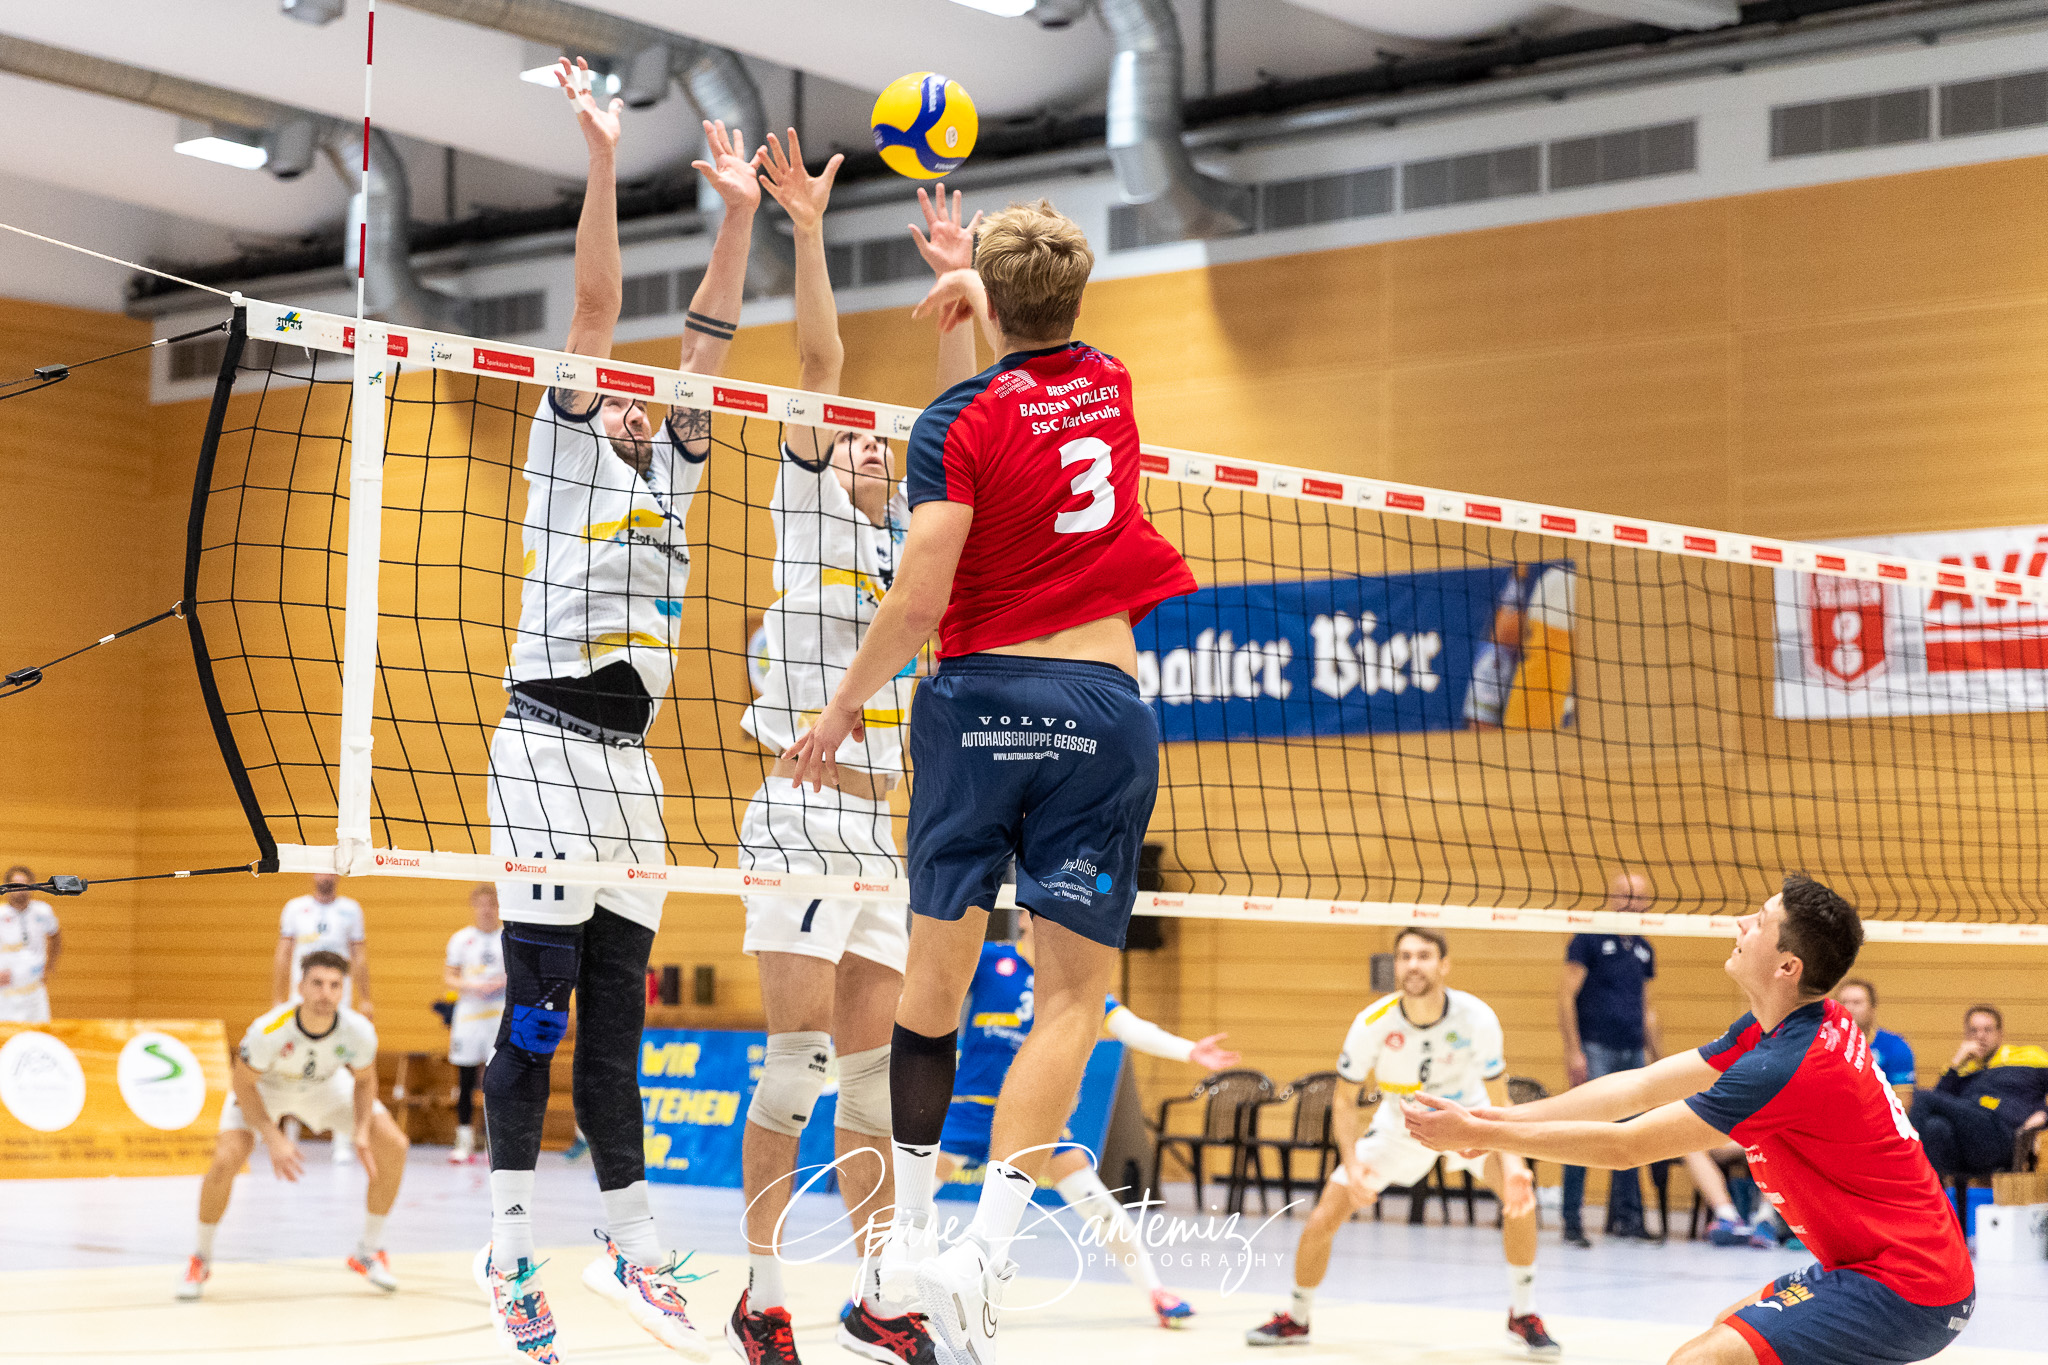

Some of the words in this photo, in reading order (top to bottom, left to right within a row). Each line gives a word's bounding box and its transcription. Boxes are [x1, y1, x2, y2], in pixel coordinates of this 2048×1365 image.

[277, 317, 301, 330] HUCK
[437, 351, 452, 360] Zapf
[486, 358, 509, 369] Sparkasse
[509, 362, 531, 373] Nürnberg
[608, 378, 631, 387] Sparkasse
[997, 373, 1013, 383] SSC
[1046, 377, 1093, 396] BRENTEL
[1019, 400, 1070, 417] BADEN
[1070, 385, 1120, 407] VOLLEYS
[1032, 419, 1060, 435] SSC
[1061, 405, 1121, 429] Karlsruhe
[1054, 436, 1116, 534] 3
[1310, 610, 1442, 699] Bier
[978, 715, 1077, 729] VOLVO
[961, 731, 1052, 748] AUTOHAUSGRUPPE
[1054, 733, 1097, 755] GEISSER
[385, 856, 420, 867] Marmot
[514, 862, 547, 874] Marmot
[636, 868, 667, 880] Marmot
[752, 877, 781, 887] Marmot
[861, 883, 889, 892] Marmot
[641, 1041, 701, 1078] WIR
[639, 1087, 741, 1127] TEHEN
